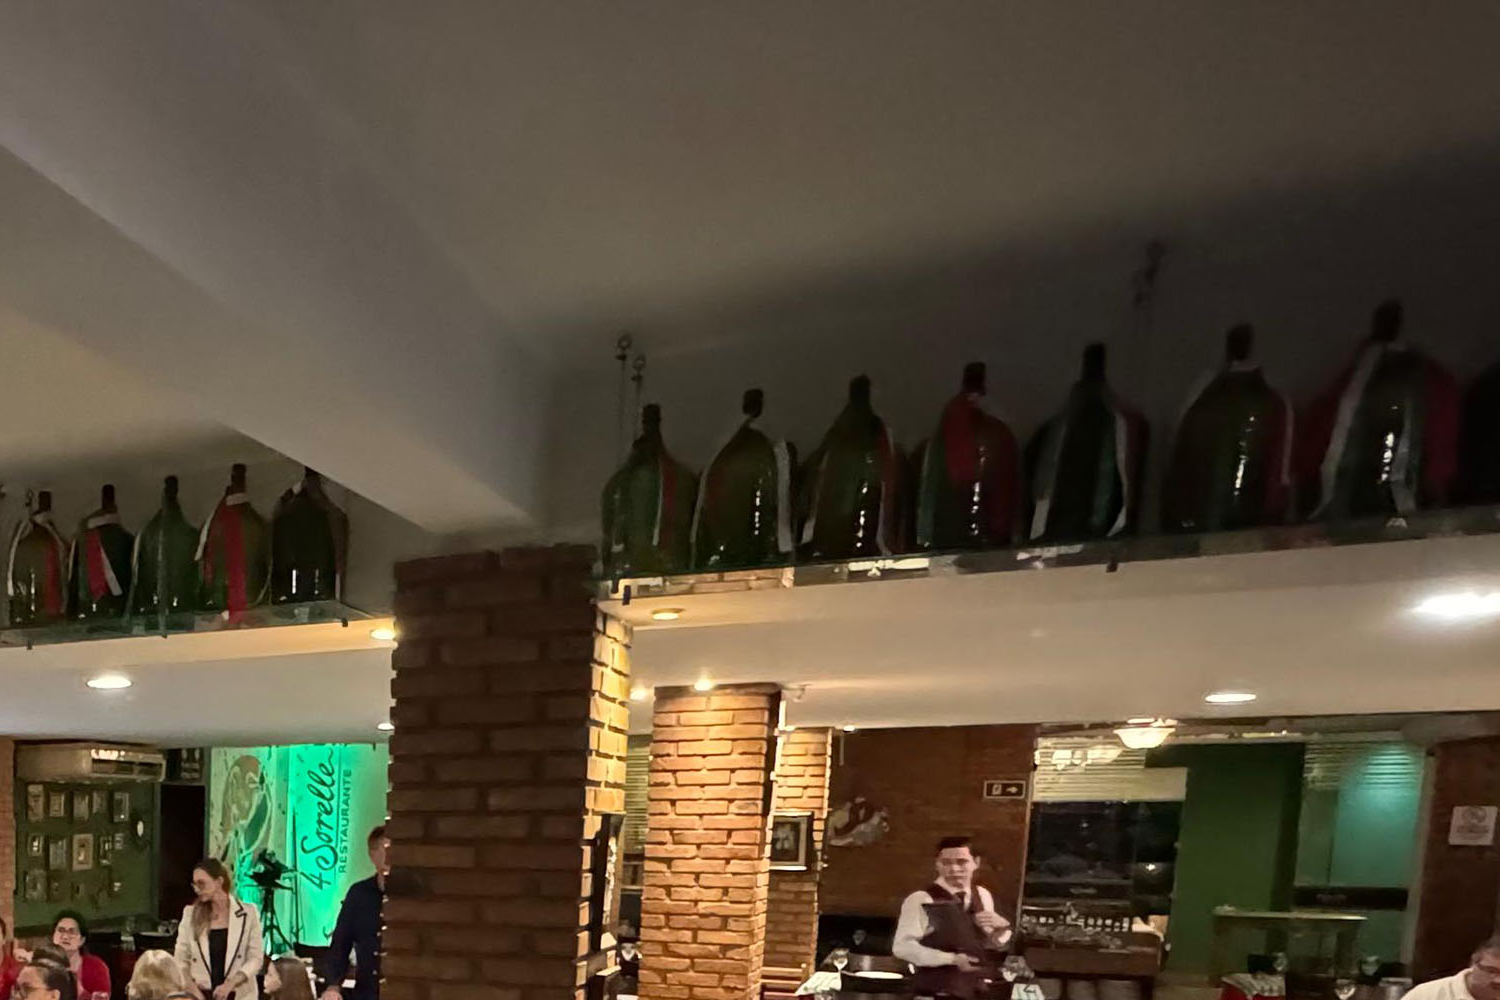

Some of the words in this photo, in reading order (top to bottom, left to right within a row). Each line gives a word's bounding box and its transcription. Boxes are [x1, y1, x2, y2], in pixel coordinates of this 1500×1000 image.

[301, 748, 339, 871] Sorelle
[338, 769, 353, 874] RESTAURANTE
[297, 871, 329, 891] 4
